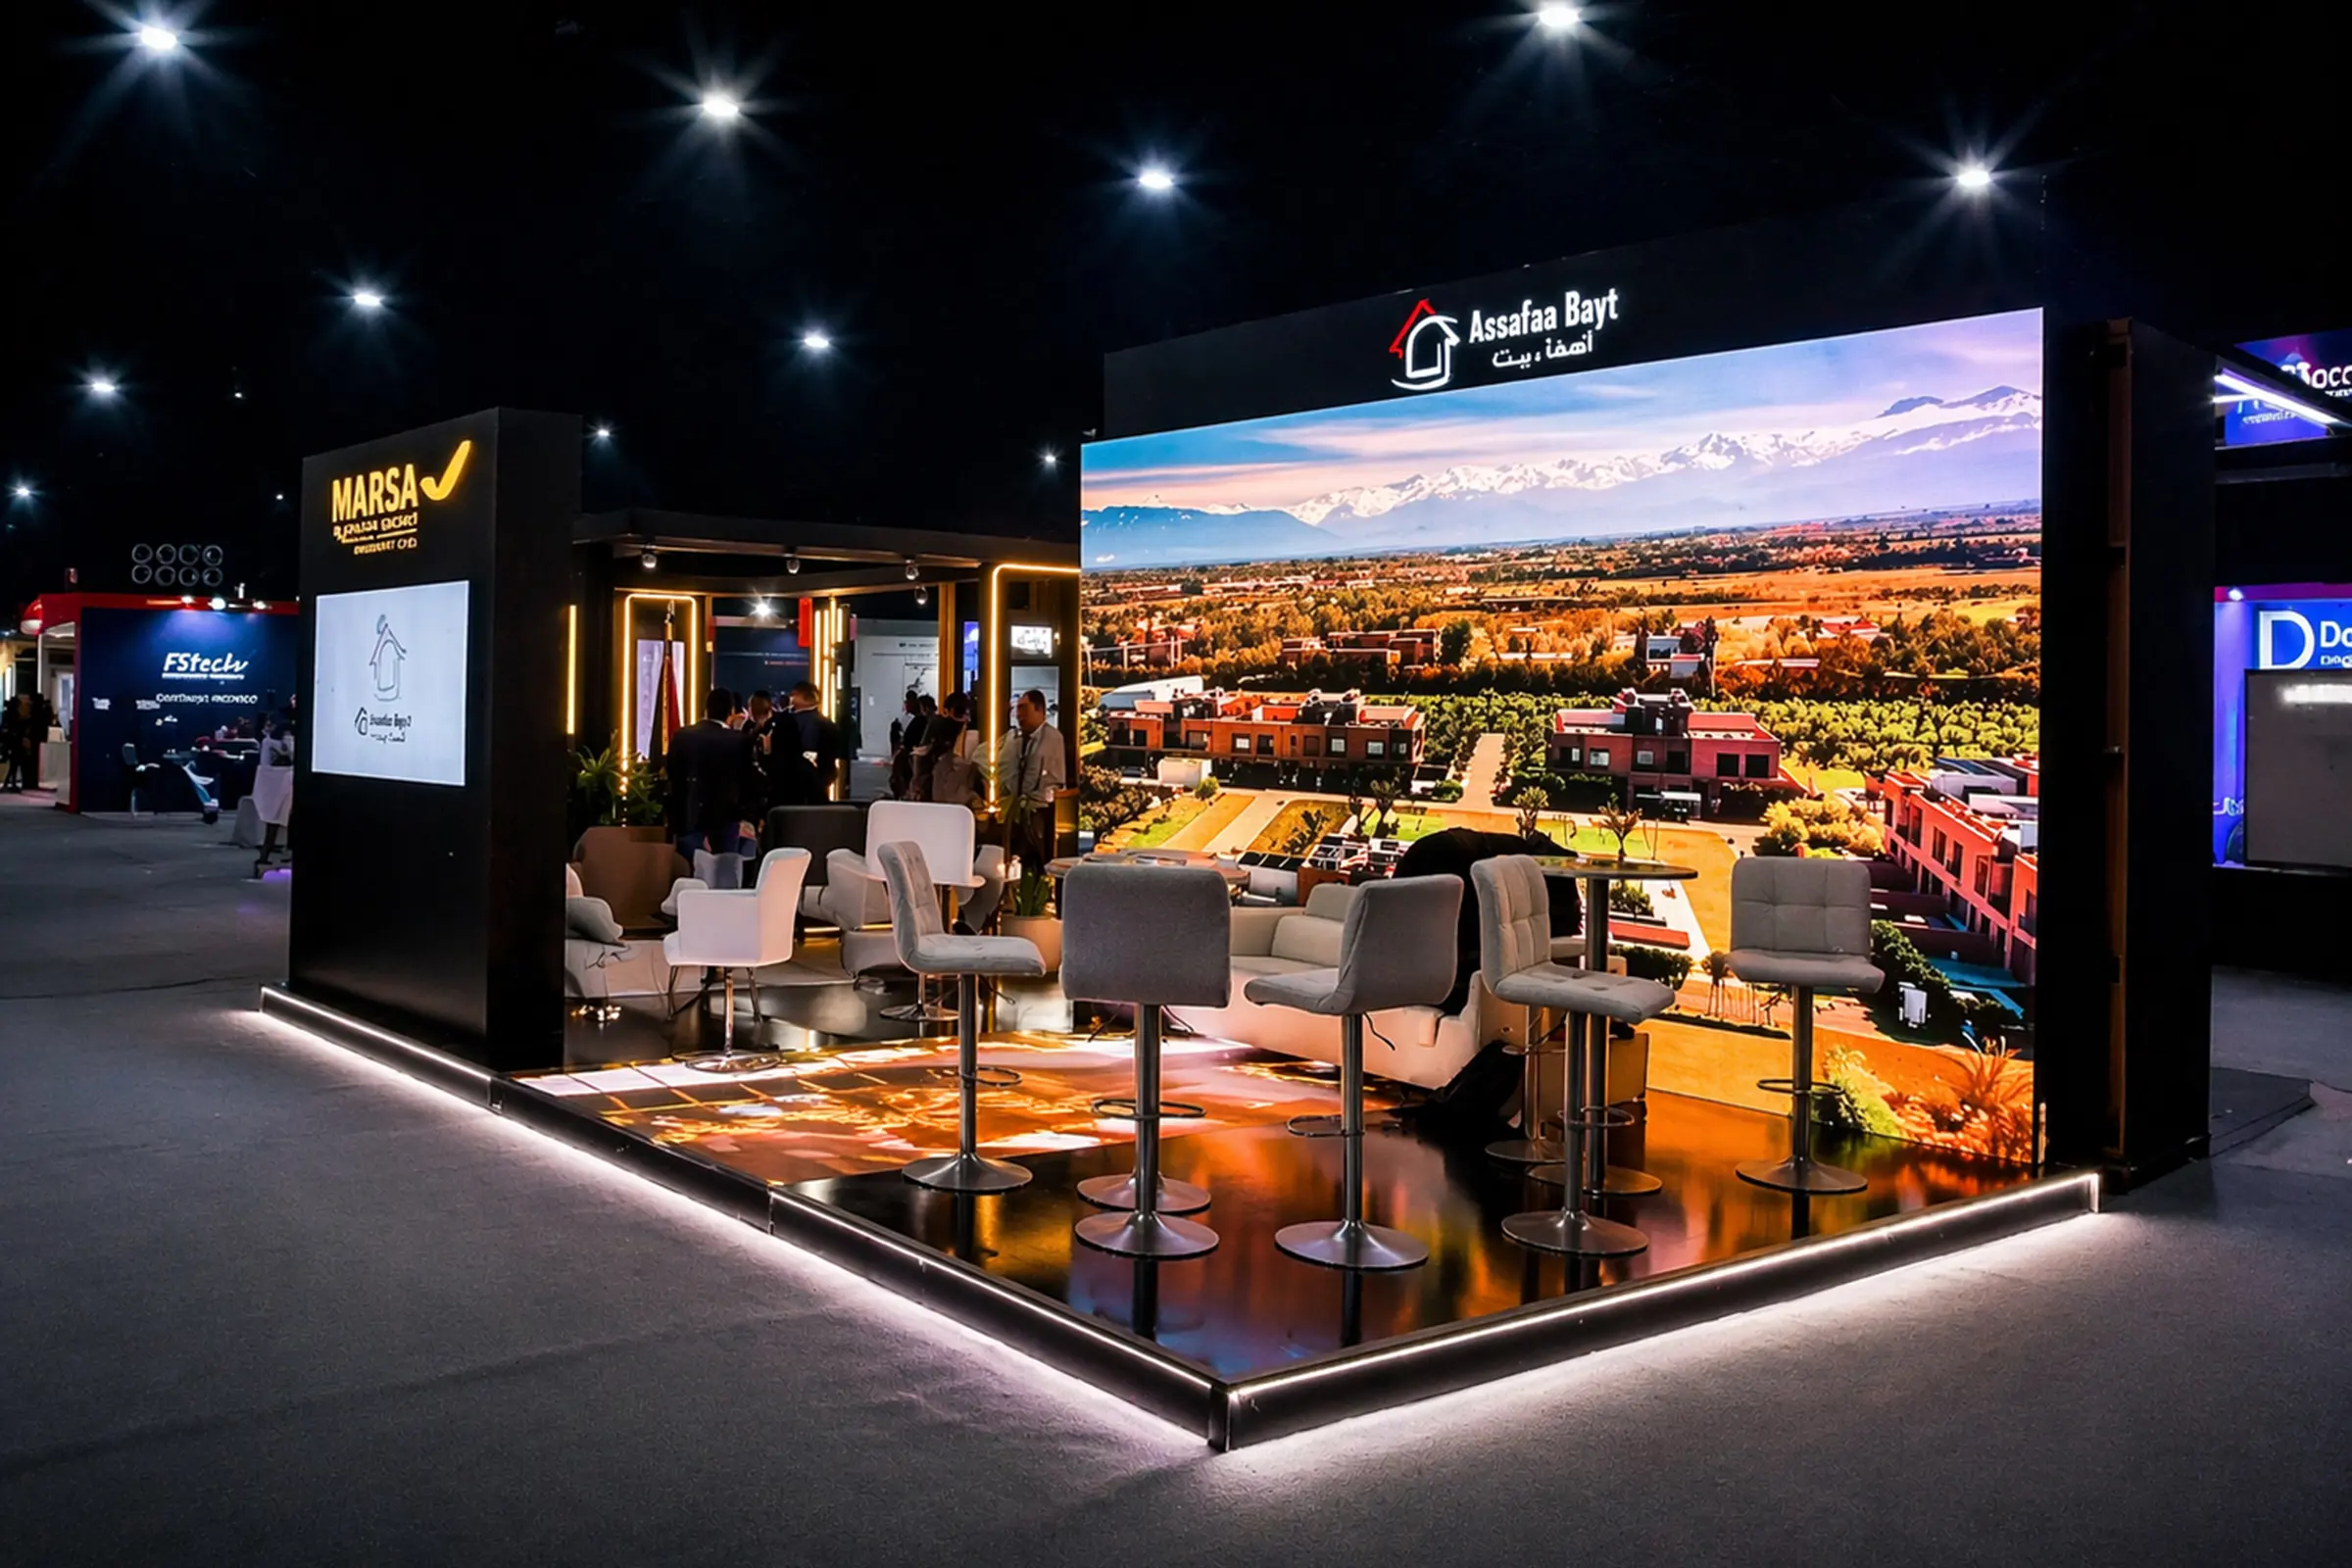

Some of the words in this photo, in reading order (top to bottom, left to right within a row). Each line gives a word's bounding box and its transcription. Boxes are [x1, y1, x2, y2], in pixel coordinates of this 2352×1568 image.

[1469, 299, 1557, 343] Assafaa
[1564, 287, 1619, 330] Bayt
[332, 464, 419, 522] MARSA
